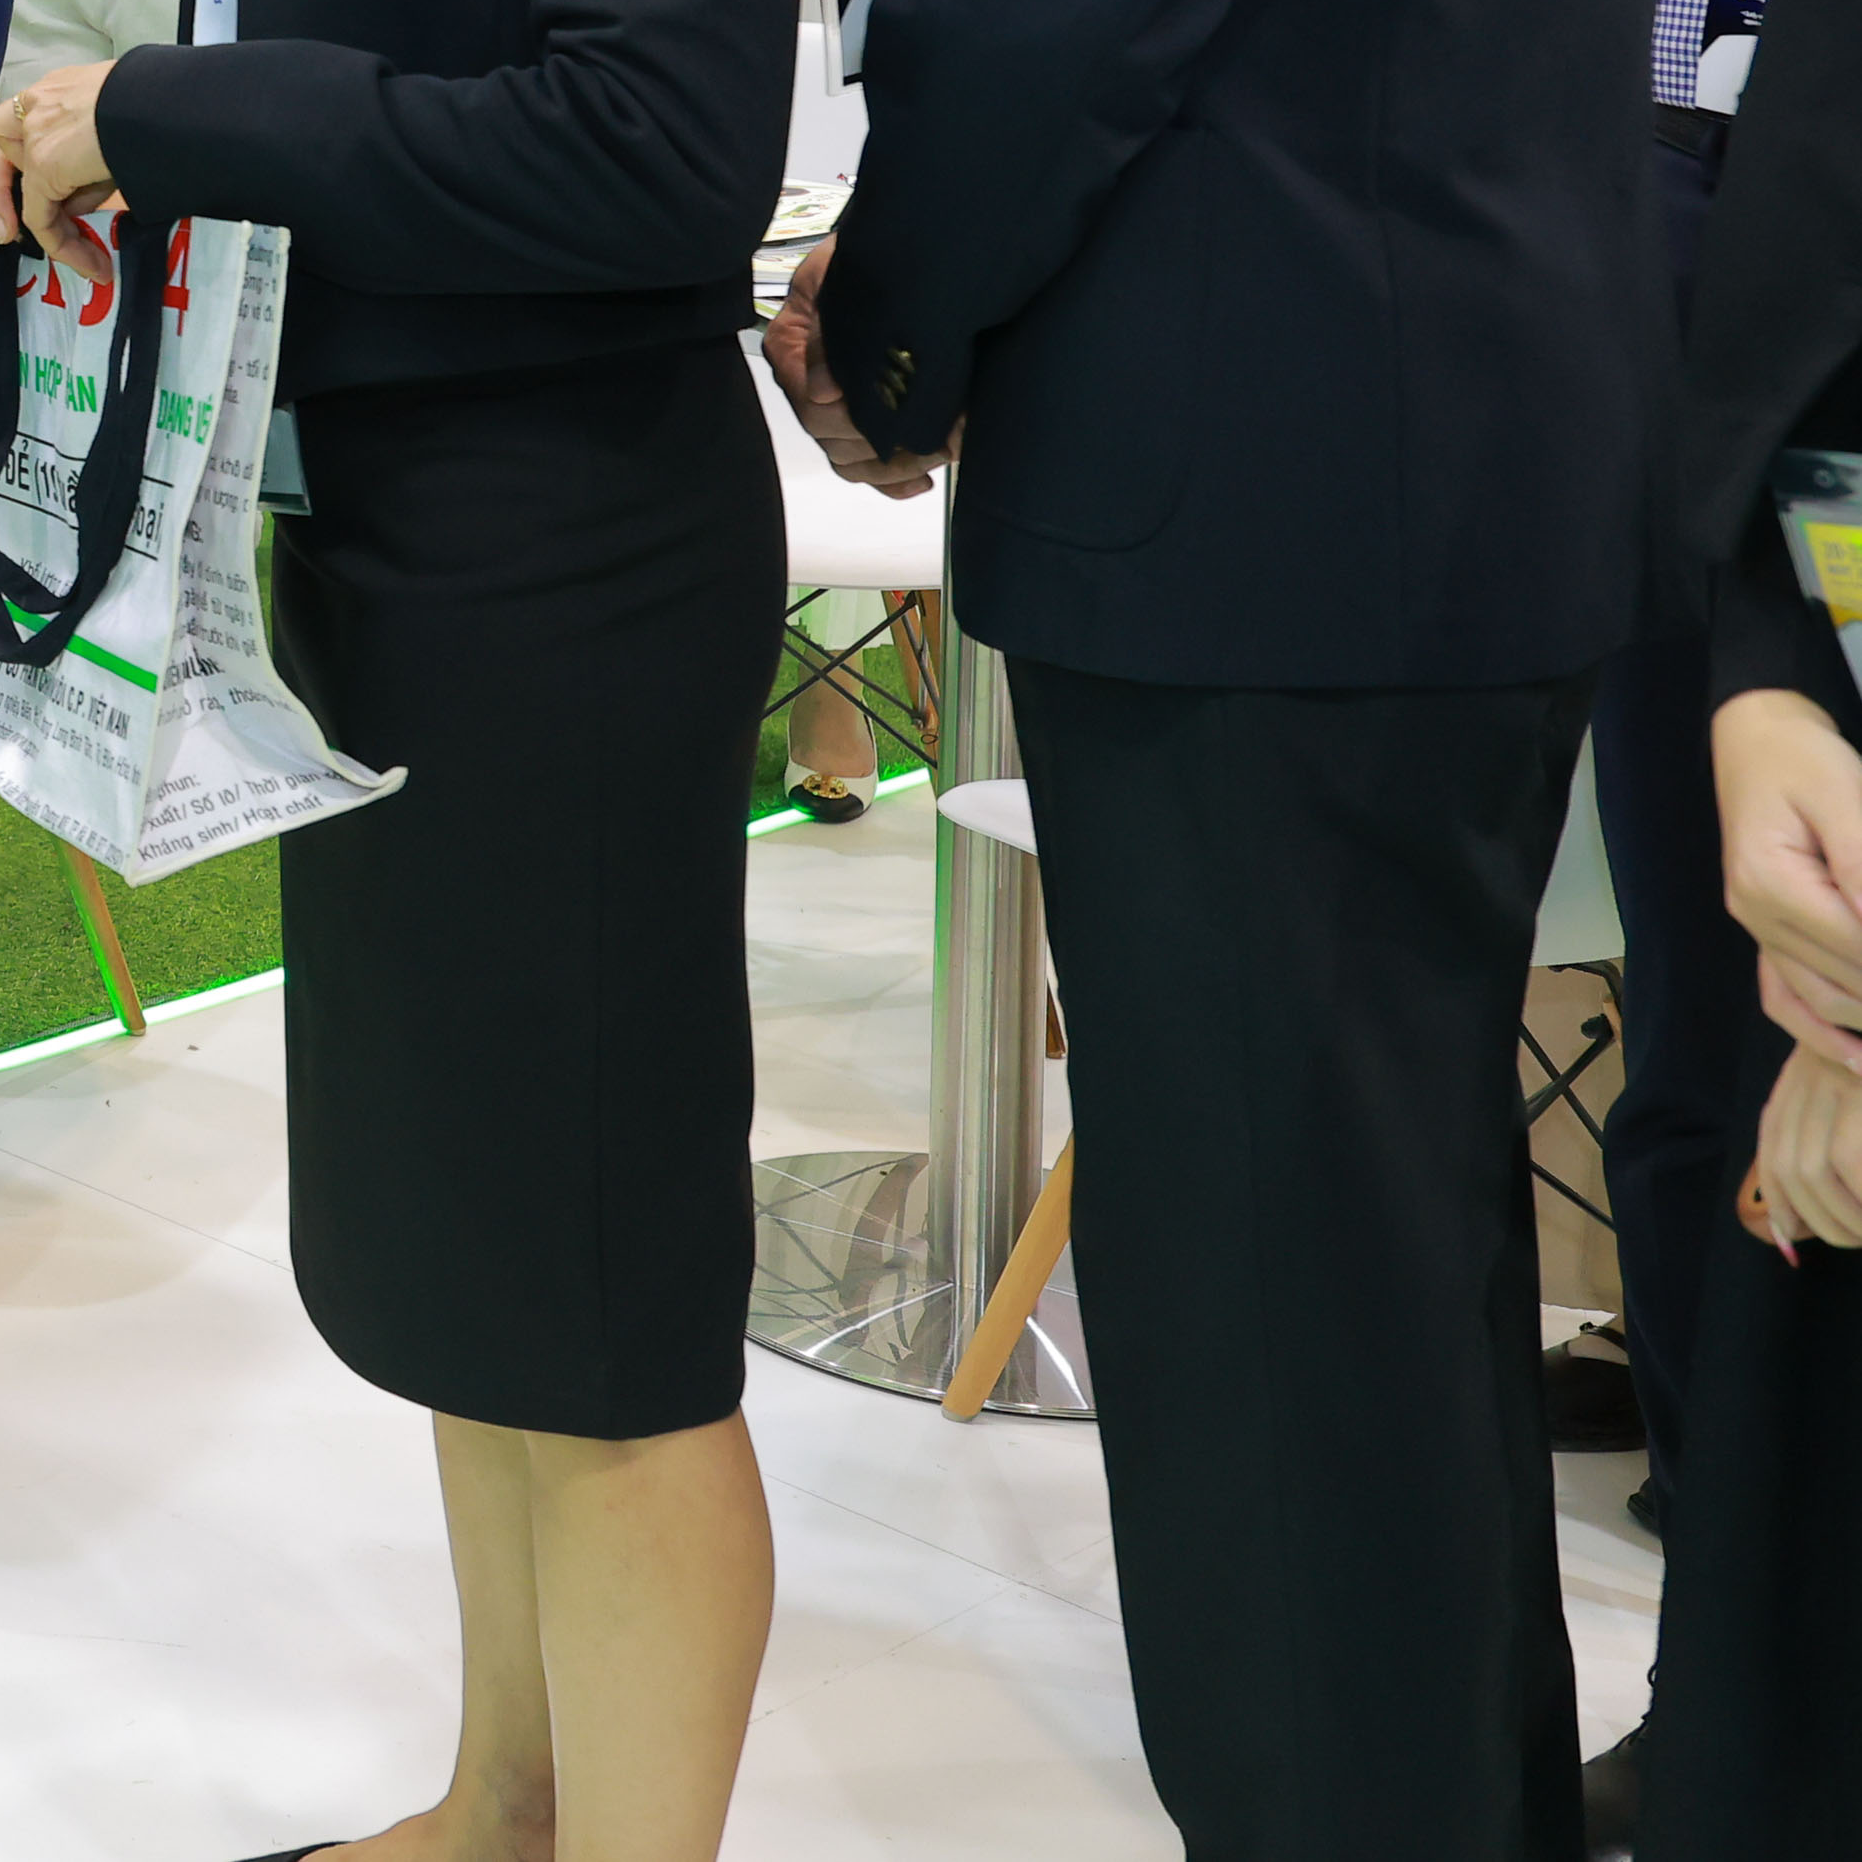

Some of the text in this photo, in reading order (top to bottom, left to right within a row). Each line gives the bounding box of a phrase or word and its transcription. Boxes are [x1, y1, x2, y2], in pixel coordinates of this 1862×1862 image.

[138, 834, 195, 862] Kháng
[197, 817, 240, 846] sinh/
[286, 792, 324, 816] chất
[191, 791, 215, 816] Số
